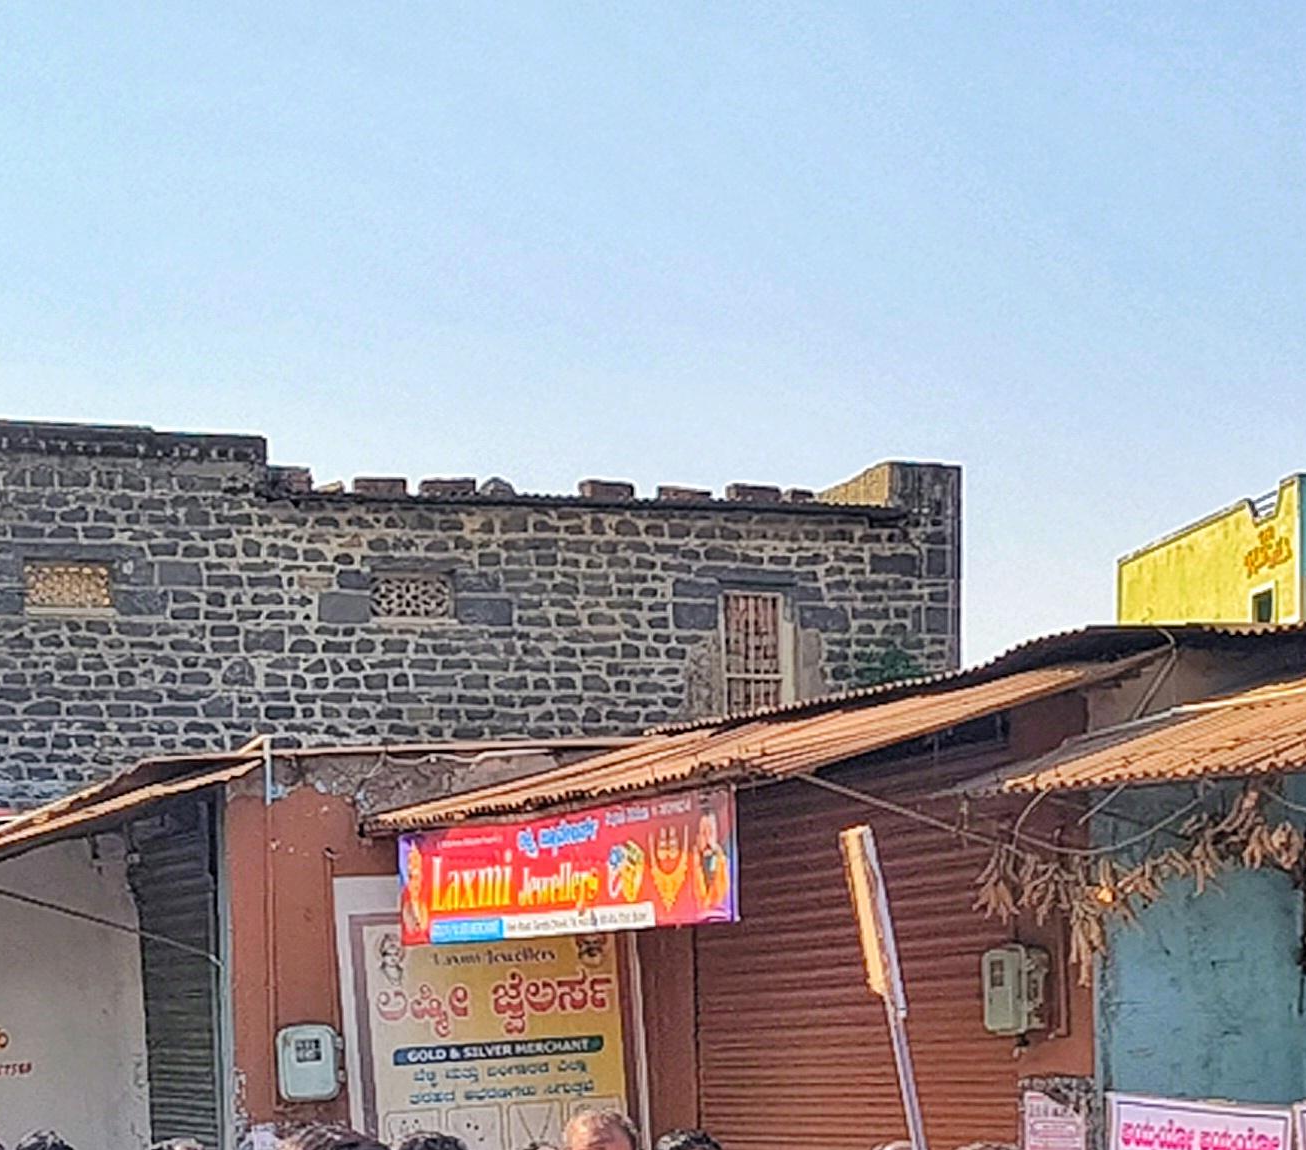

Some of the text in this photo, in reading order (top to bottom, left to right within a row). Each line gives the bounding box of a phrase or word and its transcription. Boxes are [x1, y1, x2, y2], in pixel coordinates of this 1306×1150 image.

[431, 850, 600, 912] Laxmi Jewellers
[406, 1038, 591, 1063] GOLD & SILVER MERCHANT
